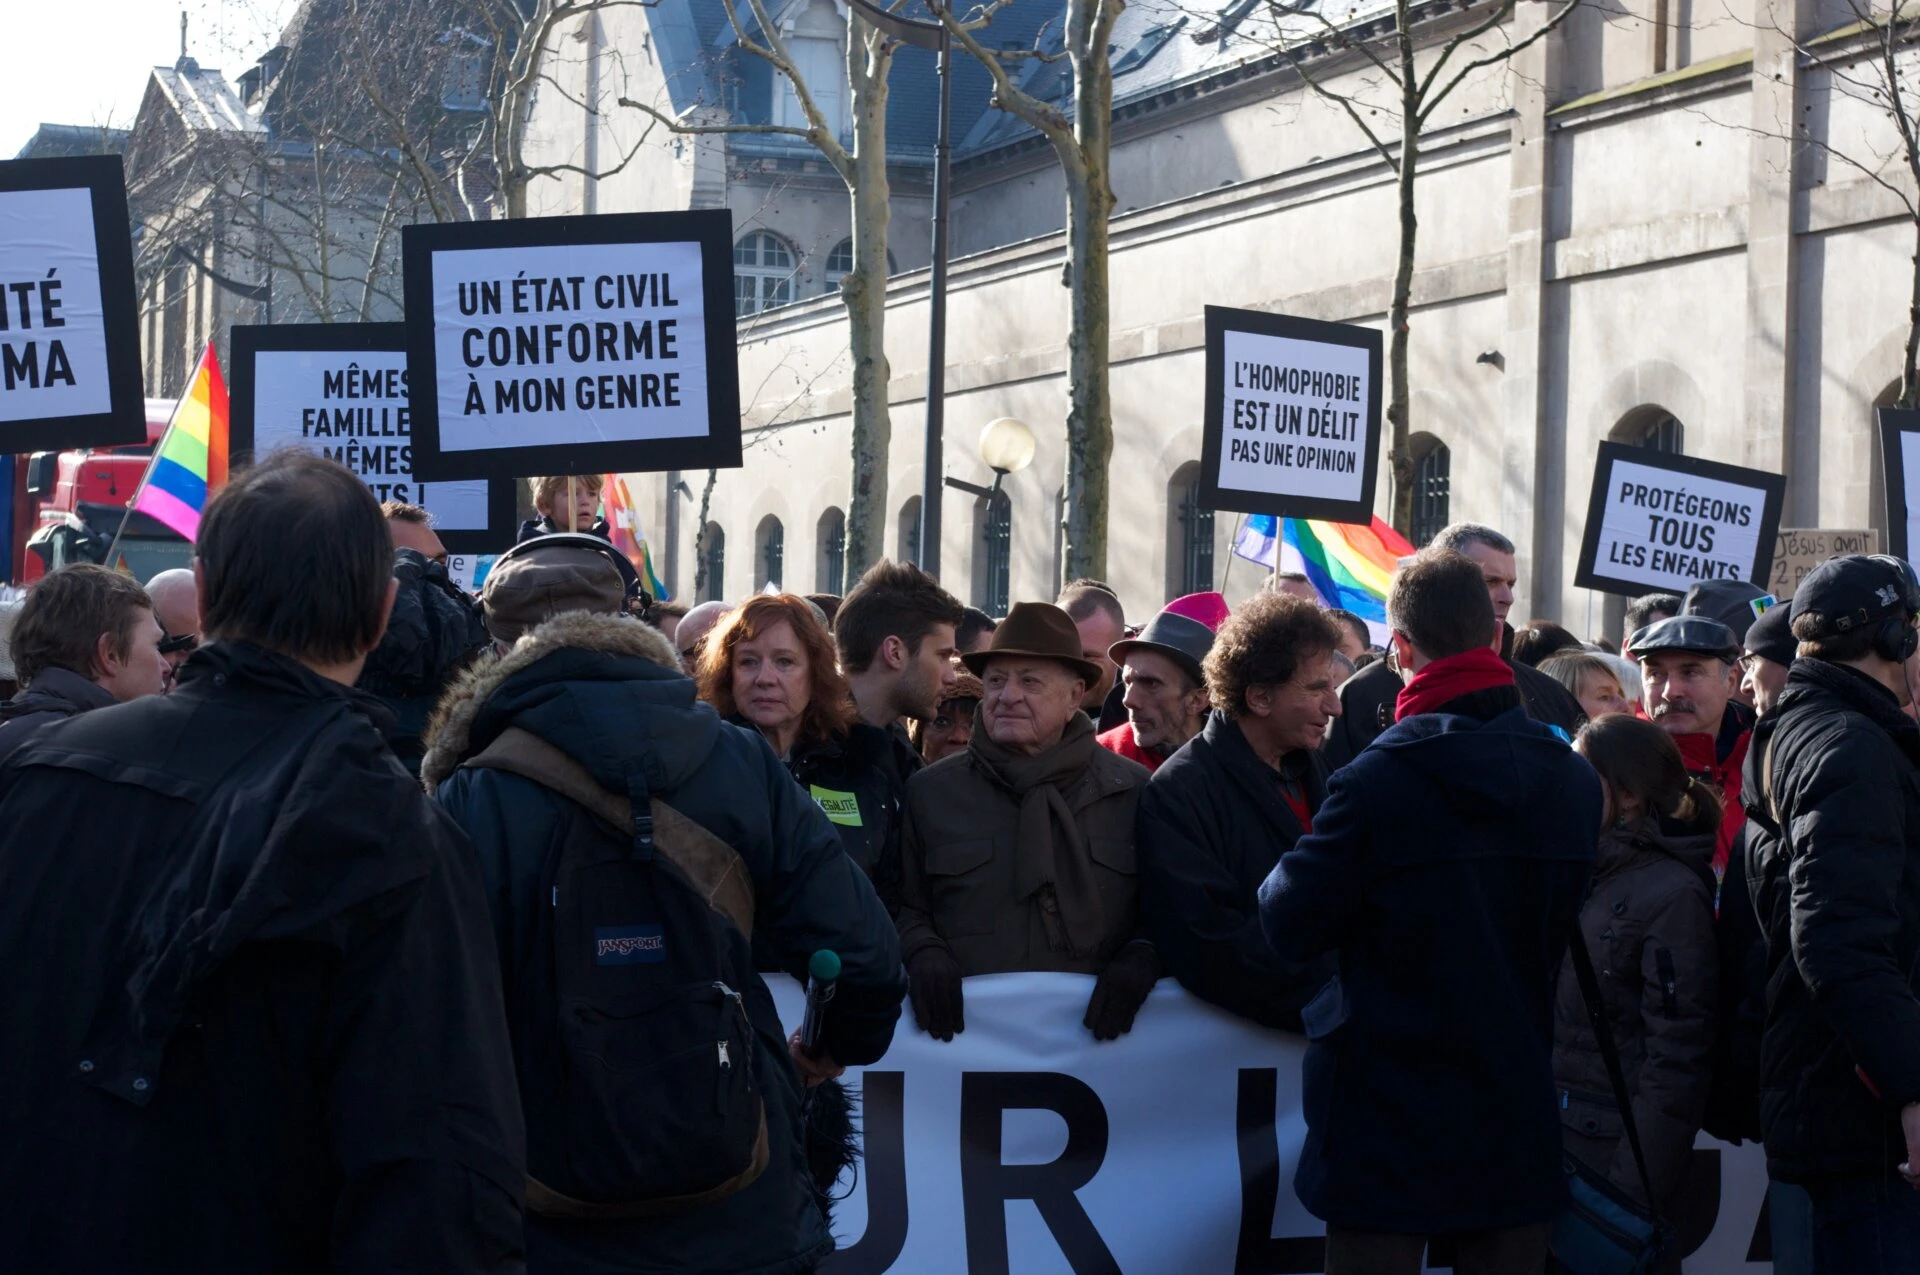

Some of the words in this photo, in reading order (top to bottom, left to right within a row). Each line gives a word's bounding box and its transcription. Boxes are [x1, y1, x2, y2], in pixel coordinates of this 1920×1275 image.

[458, 280, 502, 316] UN
[512, 270, 585, 314] ÉTAT
[594, 272, 679, 310] CIVIL
[462, 319, 679, 368] CONFORME
[1, 339, 77, 391] MA
[1234, 361, 1360, 402] L'HOMOPHOBIE
[463, 372, 487, 416] À
[495, 377, 566, 414] MON
[575, 372, 681, 411] GENRE
[1233, 398, 1270, 432] EST
[1275, 403, 1303, 436] UN
[1307, 401, 1360, 442] DÉLIT
[1230, 438, 1261, 464] PAS
[1264, 442, 1294, 467] UNE
[1296, 445, 1356, 474] OPINION
[1619, 481, 1752, 527] PROTÉGEONS
[1648, 514, 1715, 554] TOUS
[1773, 531, 1826, 559] Jésus
[1833, 529, 1871, 553] avait
[1609, 541, 1647, 568] LES
[1650, 548, 1741, 581] ENFANTS
[1775, 560, 1789, 585] 2
